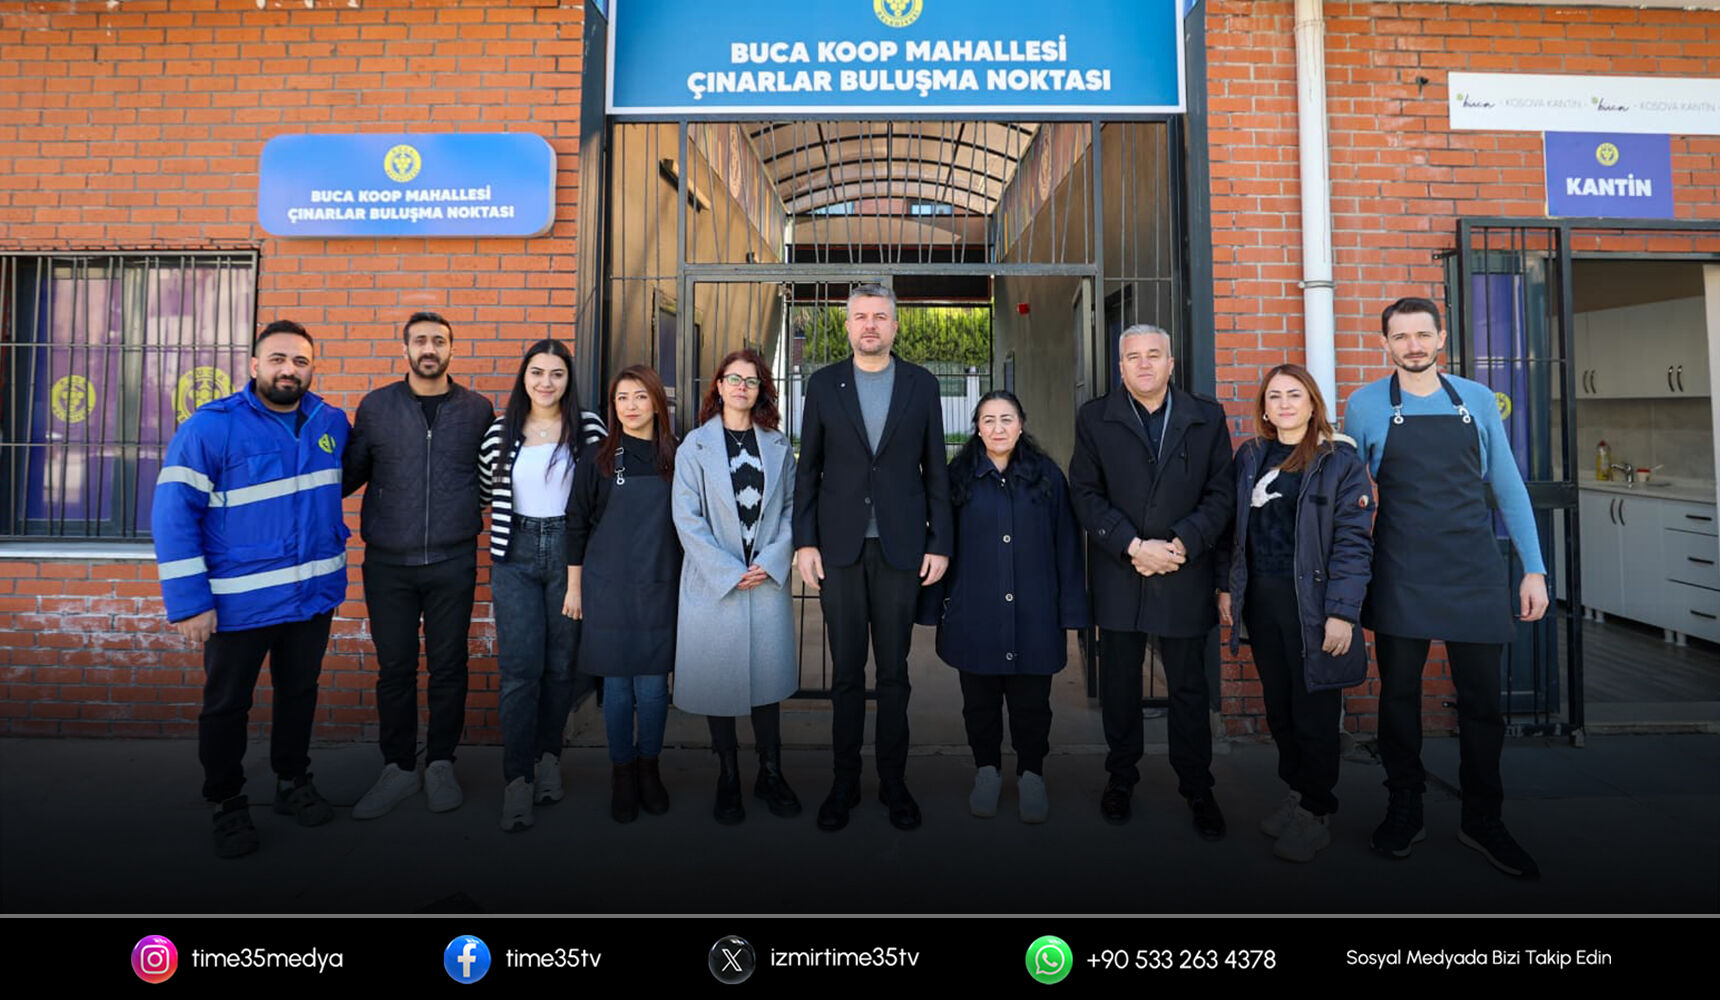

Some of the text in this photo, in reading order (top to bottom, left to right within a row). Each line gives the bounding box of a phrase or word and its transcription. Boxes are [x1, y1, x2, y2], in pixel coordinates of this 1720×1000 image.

[731, 34, 1067, 64] BUCA KOOP MAHALLESİ
[687, 69, 1111, 100] ÇINARLAR BULUŞMA NOKTASI
[311, 185, 491, 203] BUCA KOOP MAHALLESİ
[1566, 173, 1652, 197] KANTİN
[287, 205, 515, 223] ÇINARLAR BULUŞMA NOKTASI
